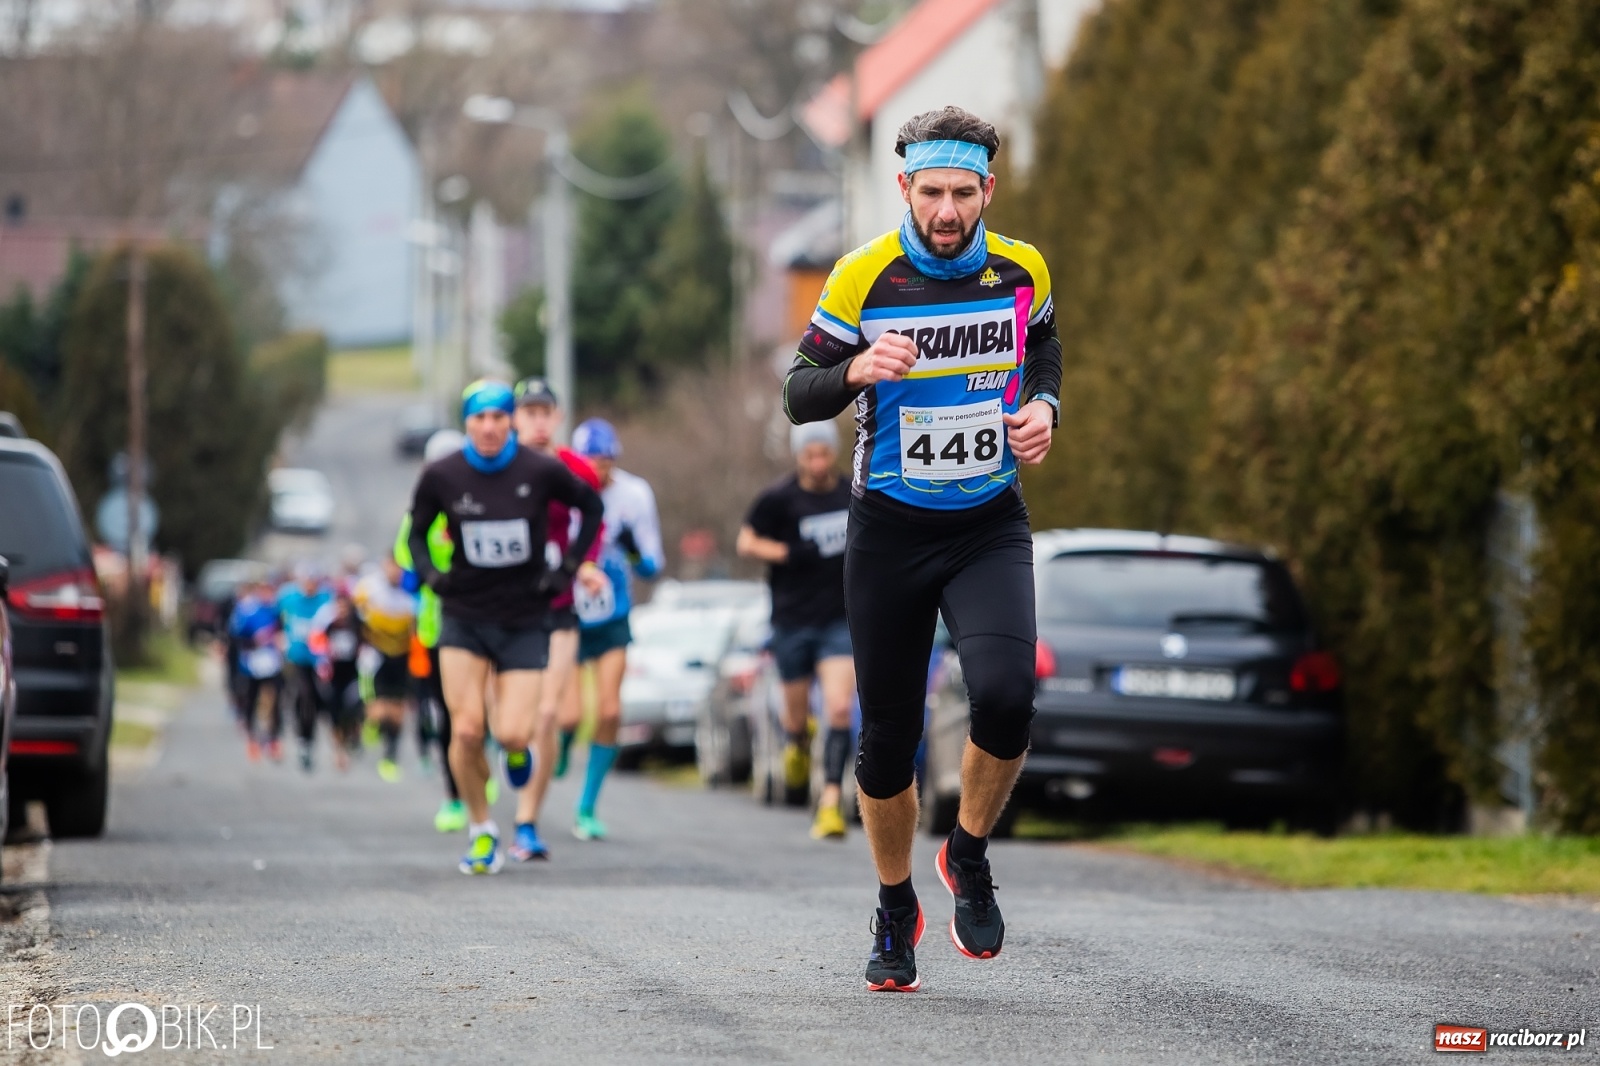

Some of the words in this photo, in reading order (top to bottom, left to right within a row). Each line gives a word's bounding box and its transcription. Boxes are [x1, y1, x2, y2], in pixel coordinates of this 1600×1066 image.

[886, 319, 1014, 361] RAMBA
[967, 370, 1010, 392] TEAM
[938, 407, 999, 421] www.personalbest.pl
[906, 428, 998, 466] 448
